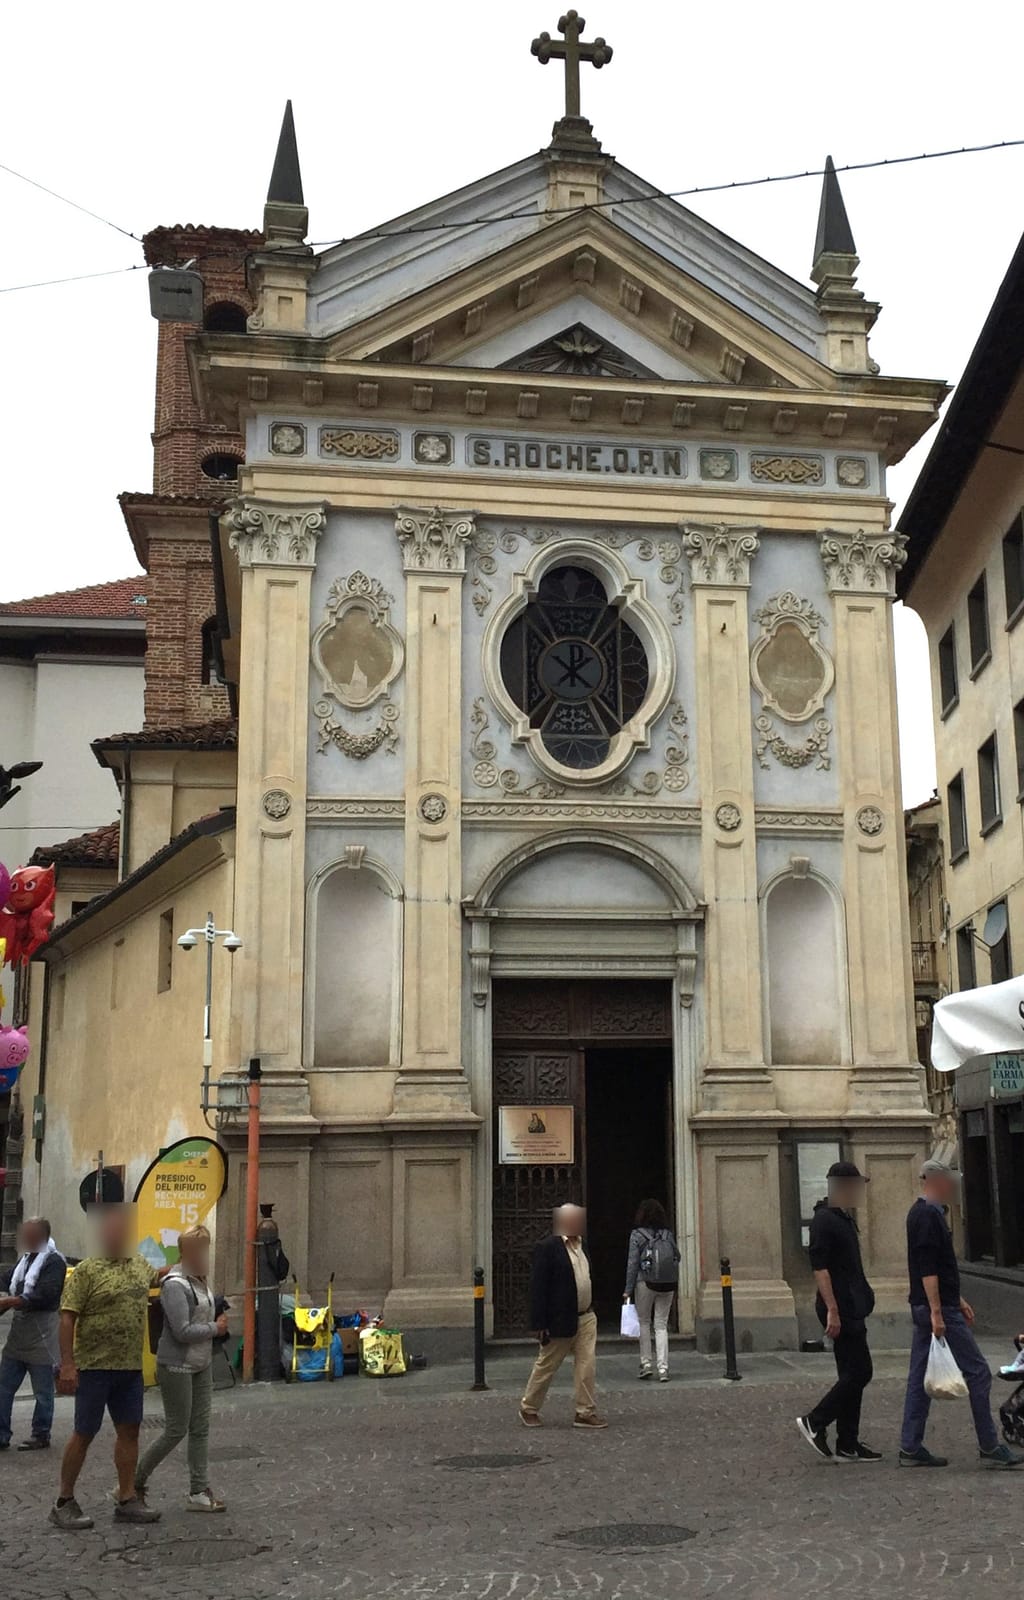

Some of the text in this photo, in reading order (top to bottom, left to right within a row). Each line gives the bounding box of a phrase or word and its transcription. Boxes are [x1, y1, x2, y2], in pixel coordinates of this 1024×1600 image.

[995, 1060, 1021, 1070] PARA
[992, 1070, 1024, 1079] FARMA
[1000, 1080, 1018, 1089] CIA
[155, 1174, 196, 1182] PRESIDIO
[155, 1183, 207, 1191] DEL RIFIUTO
[155, 1191, 206, 1200] RECYCLING
[154, 1200, 176, 1208] AREA
[179, 1203, 199, 1225] 15
